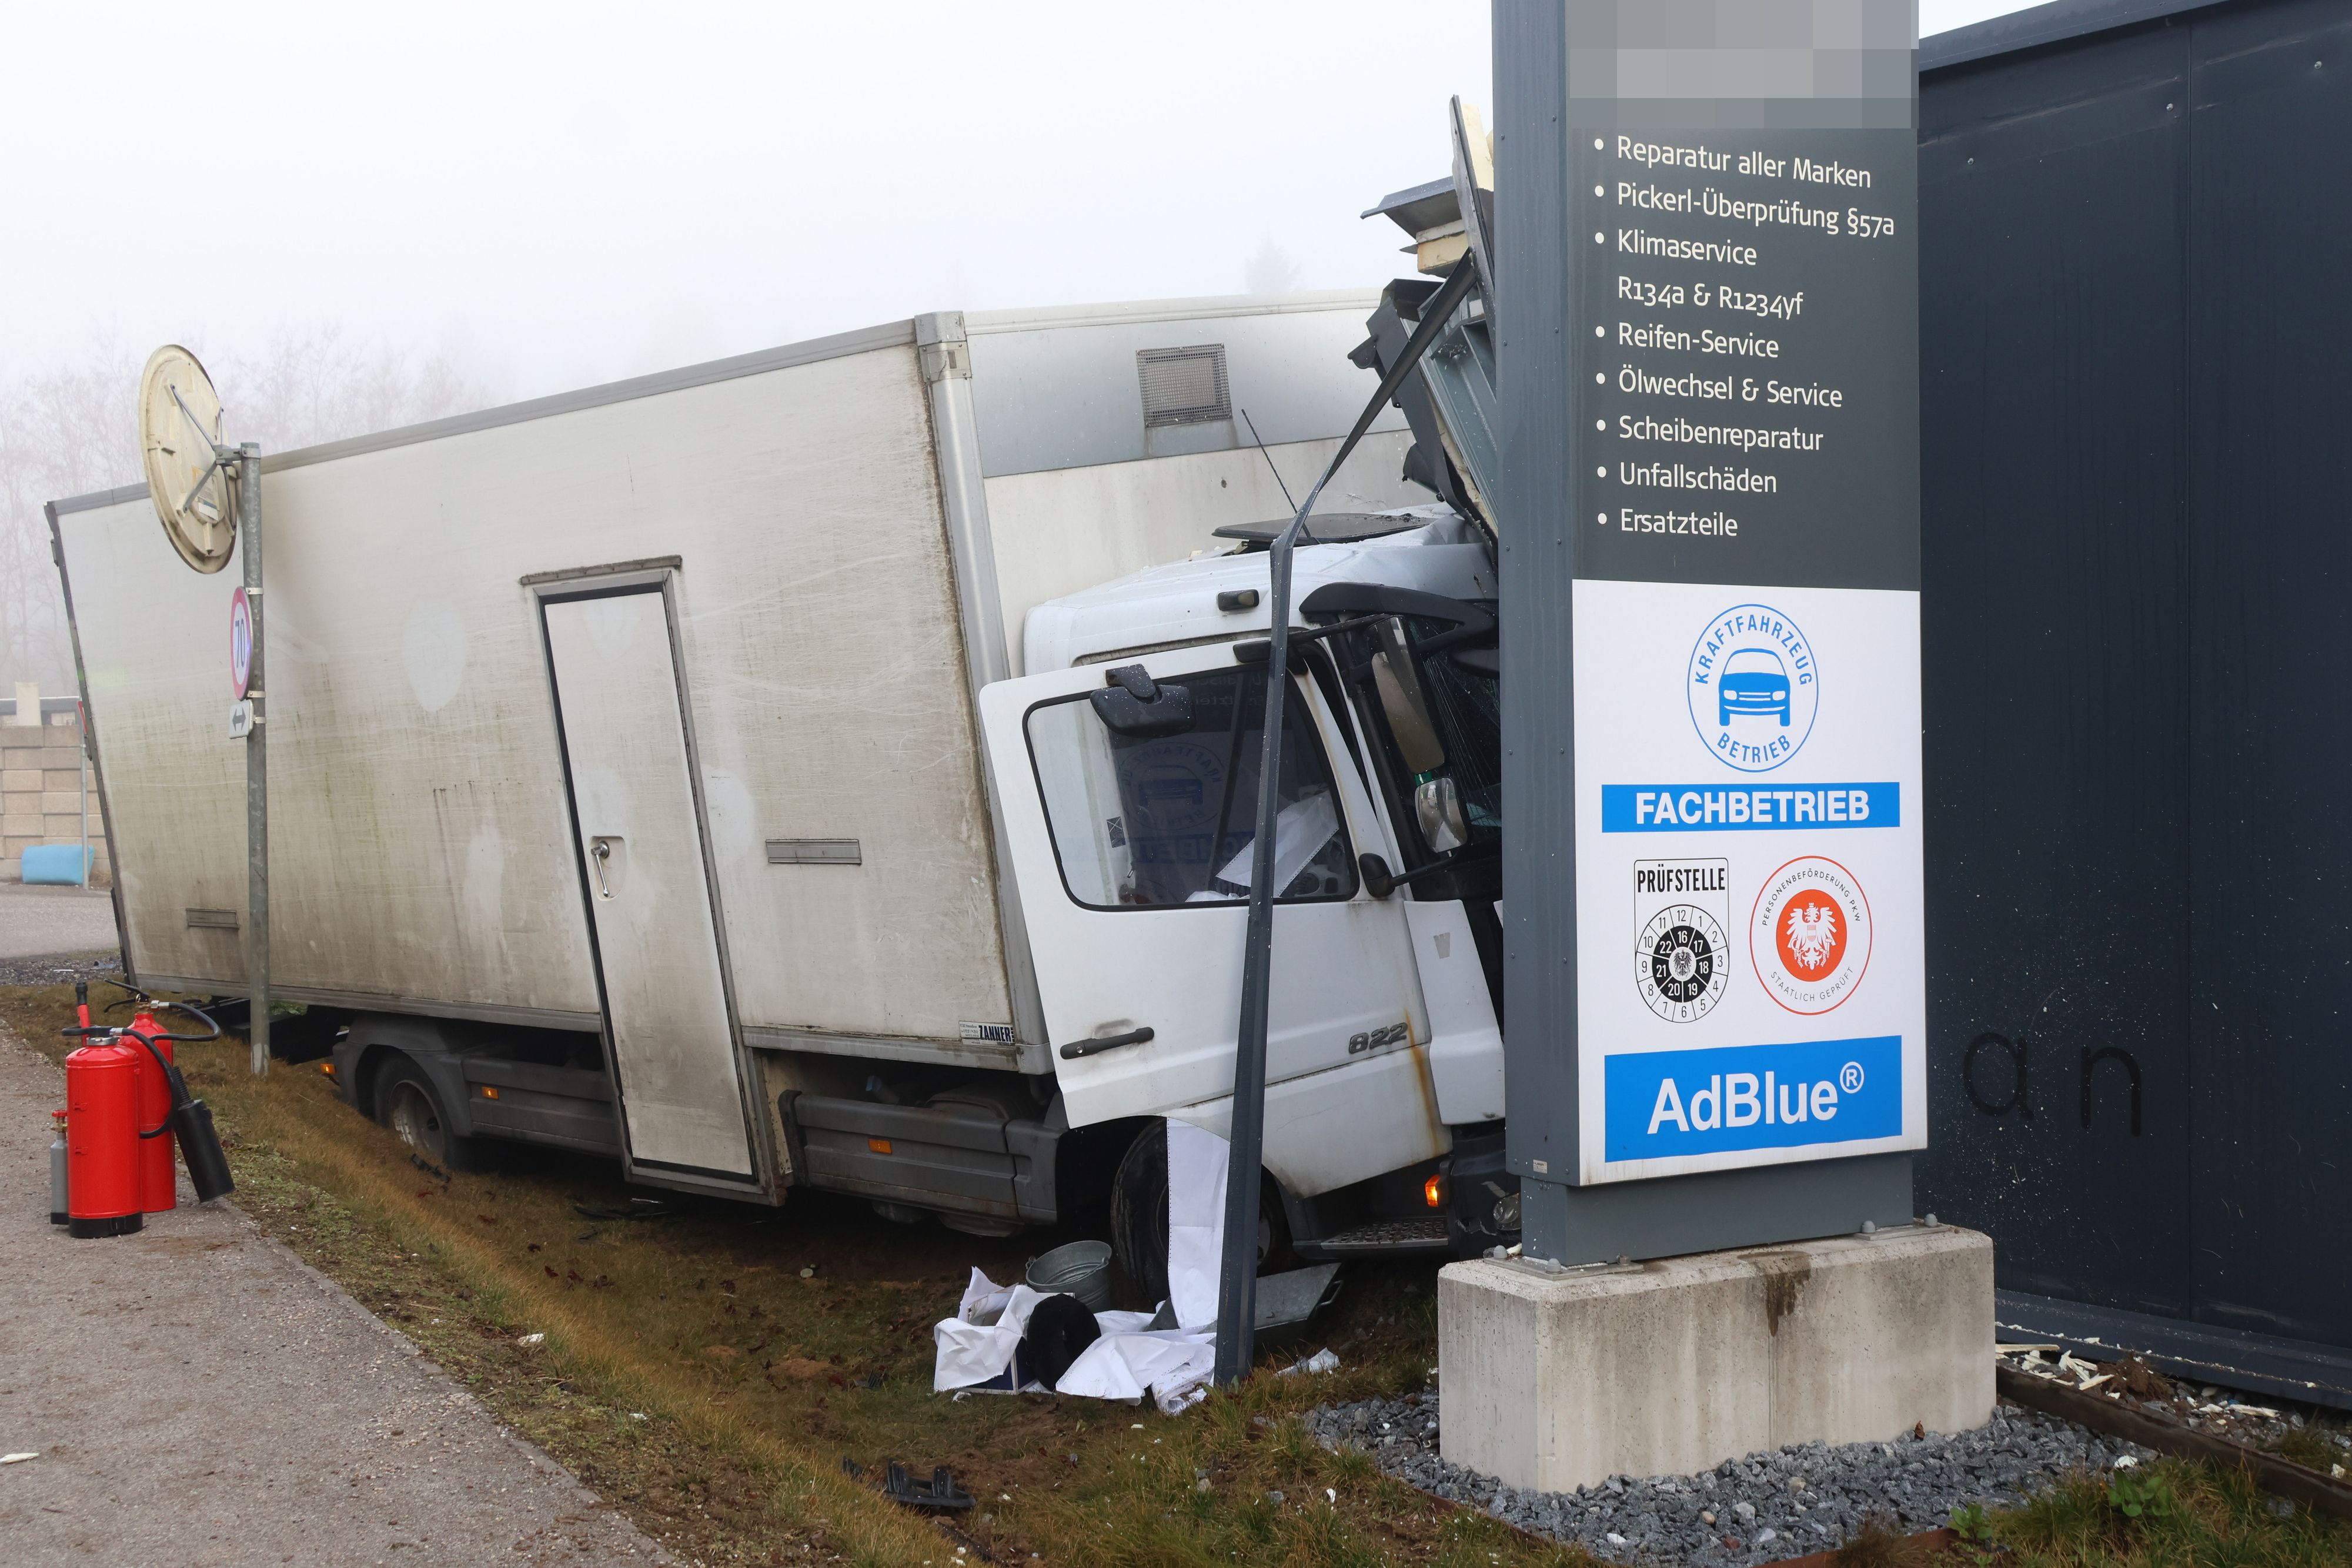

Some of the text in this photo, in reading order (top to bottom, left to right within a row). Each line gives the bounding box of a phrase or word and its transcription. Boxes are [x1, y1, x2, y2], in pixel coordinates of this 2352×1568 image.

[1618, 136, 1870, 188] Reparatur aller Marken
[1618, 182, 1894, 238] Pickerl-Überprüfung §57a
[1618, 229, 1757, 265] Klimaservice
[1619, 276, 1803, 320] R134a & R1234yf
[1619, 322, 1779, 357] Reifen-Service
[1619, 364, 1842, 407] Ölwechsel & Service
[1619, 415, 1823, 452] Scheibenreparatur
[1621, 462, 1776, 493] Unfallschäden
[1621, 509, 1738, 536] Ersatzteile
[235, 618, 245, 668] 70
[1695, 614, 1812, 685] KRAFTFAHRZEUG
[1718, 733, 1790, 763] BETRIEB
[1636, 790, 1869, 824] FACHBETRIEB
[1638, 864, 1725, 892] PRÜFSTELLE
[1762, 868, 1860, 926] PERSONENBEFÖRDERUNG PKW
[1677, 910, 1686, 922] 12
[1699, 915, 1702, 927] 1
[1659, 917, 1666, 929] 11
[1643, 936, 1653, 948] 10
[1678, 931, 1688, 943] 16
[1712, 931, 1718, 943] 2
[1660, 941, 1672, 954] 22
[1693, 940, 1703, 953] 17
[1642, 961, 1647, 973] 9
[1699, 961, 1709, 974] 18
[1718, 955, 1723, 967] 3
[1656, 965, 1666, 977] 21
[1648, 984, 1653, 996] 8
[1668, 983, 1680, 996] 20
[1688, 983, 1698, 996] 19
[1713, 981, 1719, 992] 4
[1771, 967, 1853, 1001] STAATLICH GEPRÜFT
[1663, 1002, 1668, 1014] 7
[1700, 999, 1706, 1011] 5
[1682, 1006, 1687, 1018] 6
[978, 1025, 1012, 1042] ZANNER
[1348, 1022, 1408, 1054] 822
